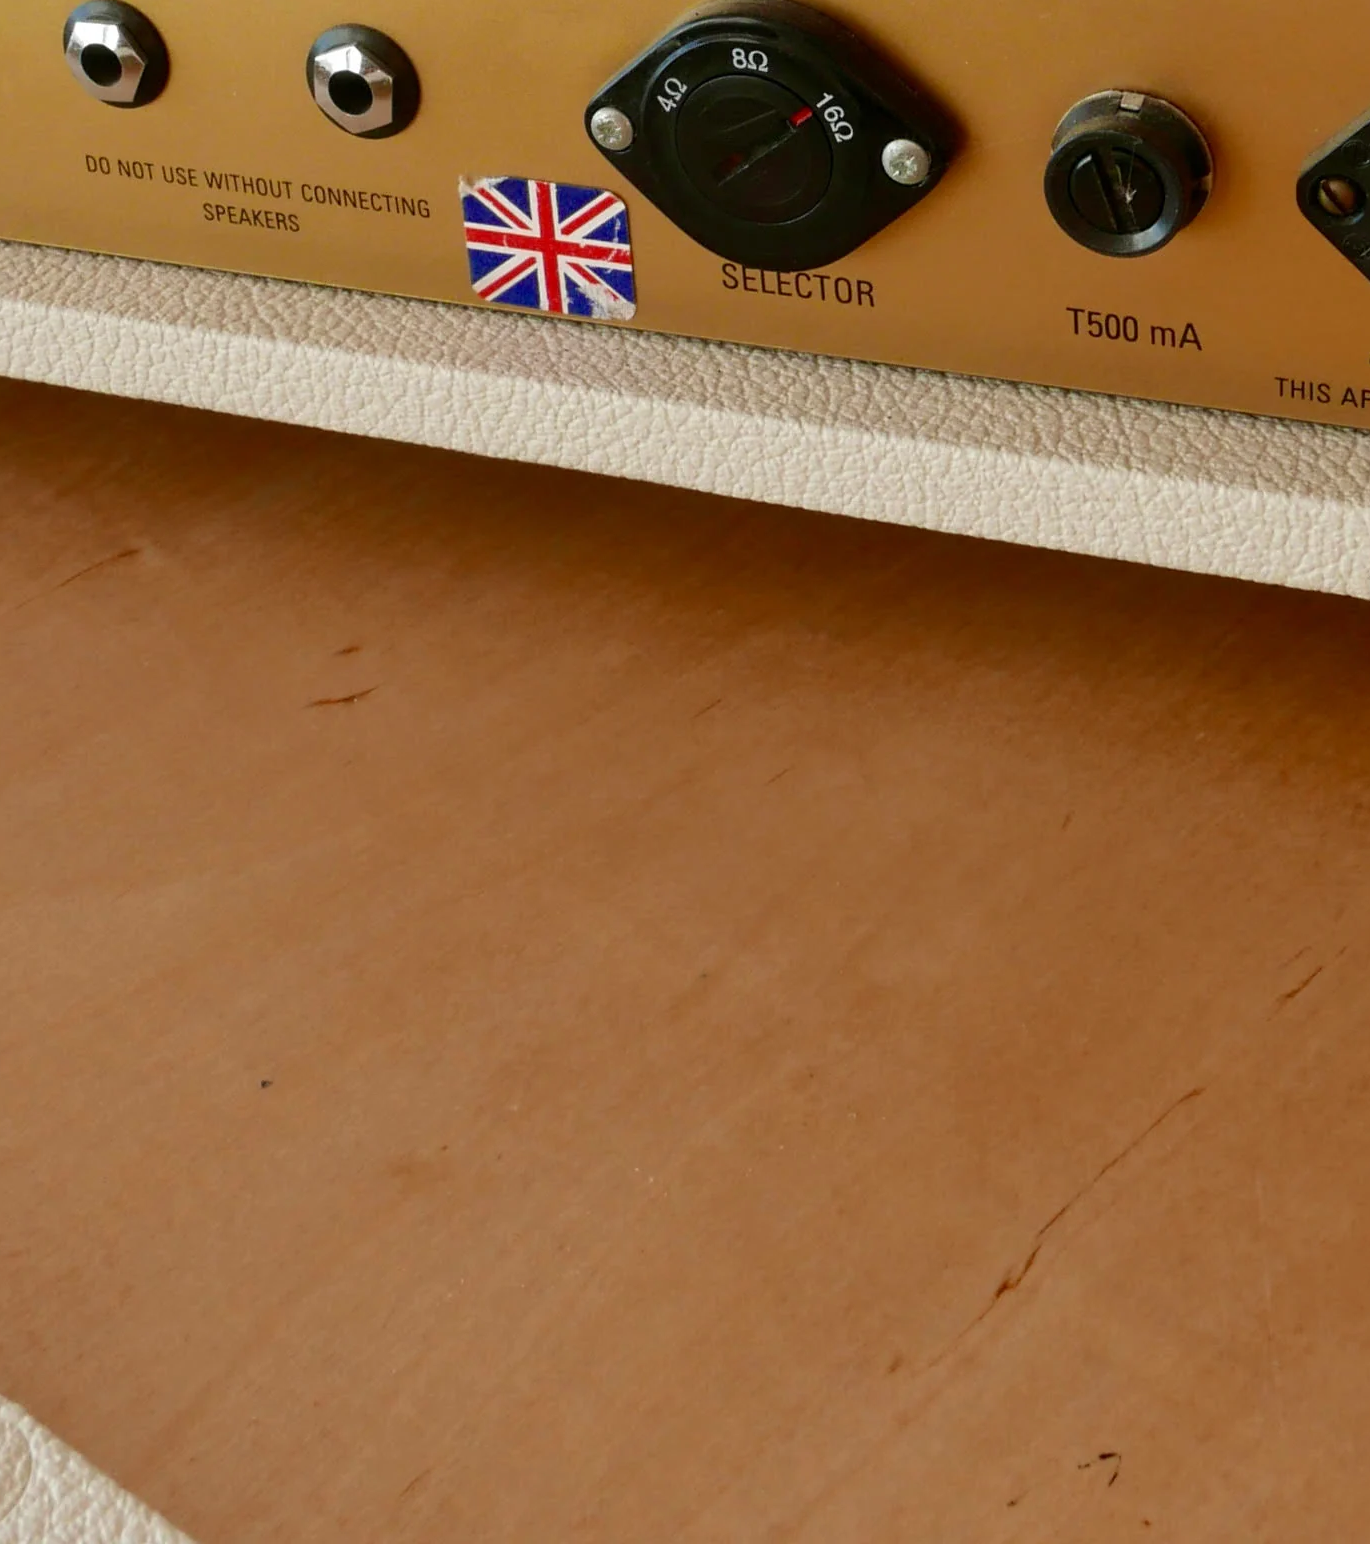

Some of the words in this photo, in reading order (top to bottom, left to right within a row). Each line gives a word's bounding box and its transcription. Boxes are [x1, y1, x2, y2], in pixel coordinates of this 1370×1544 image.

[731, 47, 769, 73] 8Ω
[655, 77, 689, 114] 4Ω
[815, 92, 854, 144] 16Ω
[85, 154, 111, 176] DO
[118, 158, 156, 182] NOT
[162, 164, 199, 188] USE
[204, 170, 294, 201] WITHOUT
[301, 183, 431, 220] CONNECTING
[203, 203, 301, 234] SPEAKERS
[721, 263, 875, 308] SELECTOR
[1065, 307, 1140, 343] T500
[1150, 322, 1203, 352] mA
[1274, 376, 1331, 404] THIS
